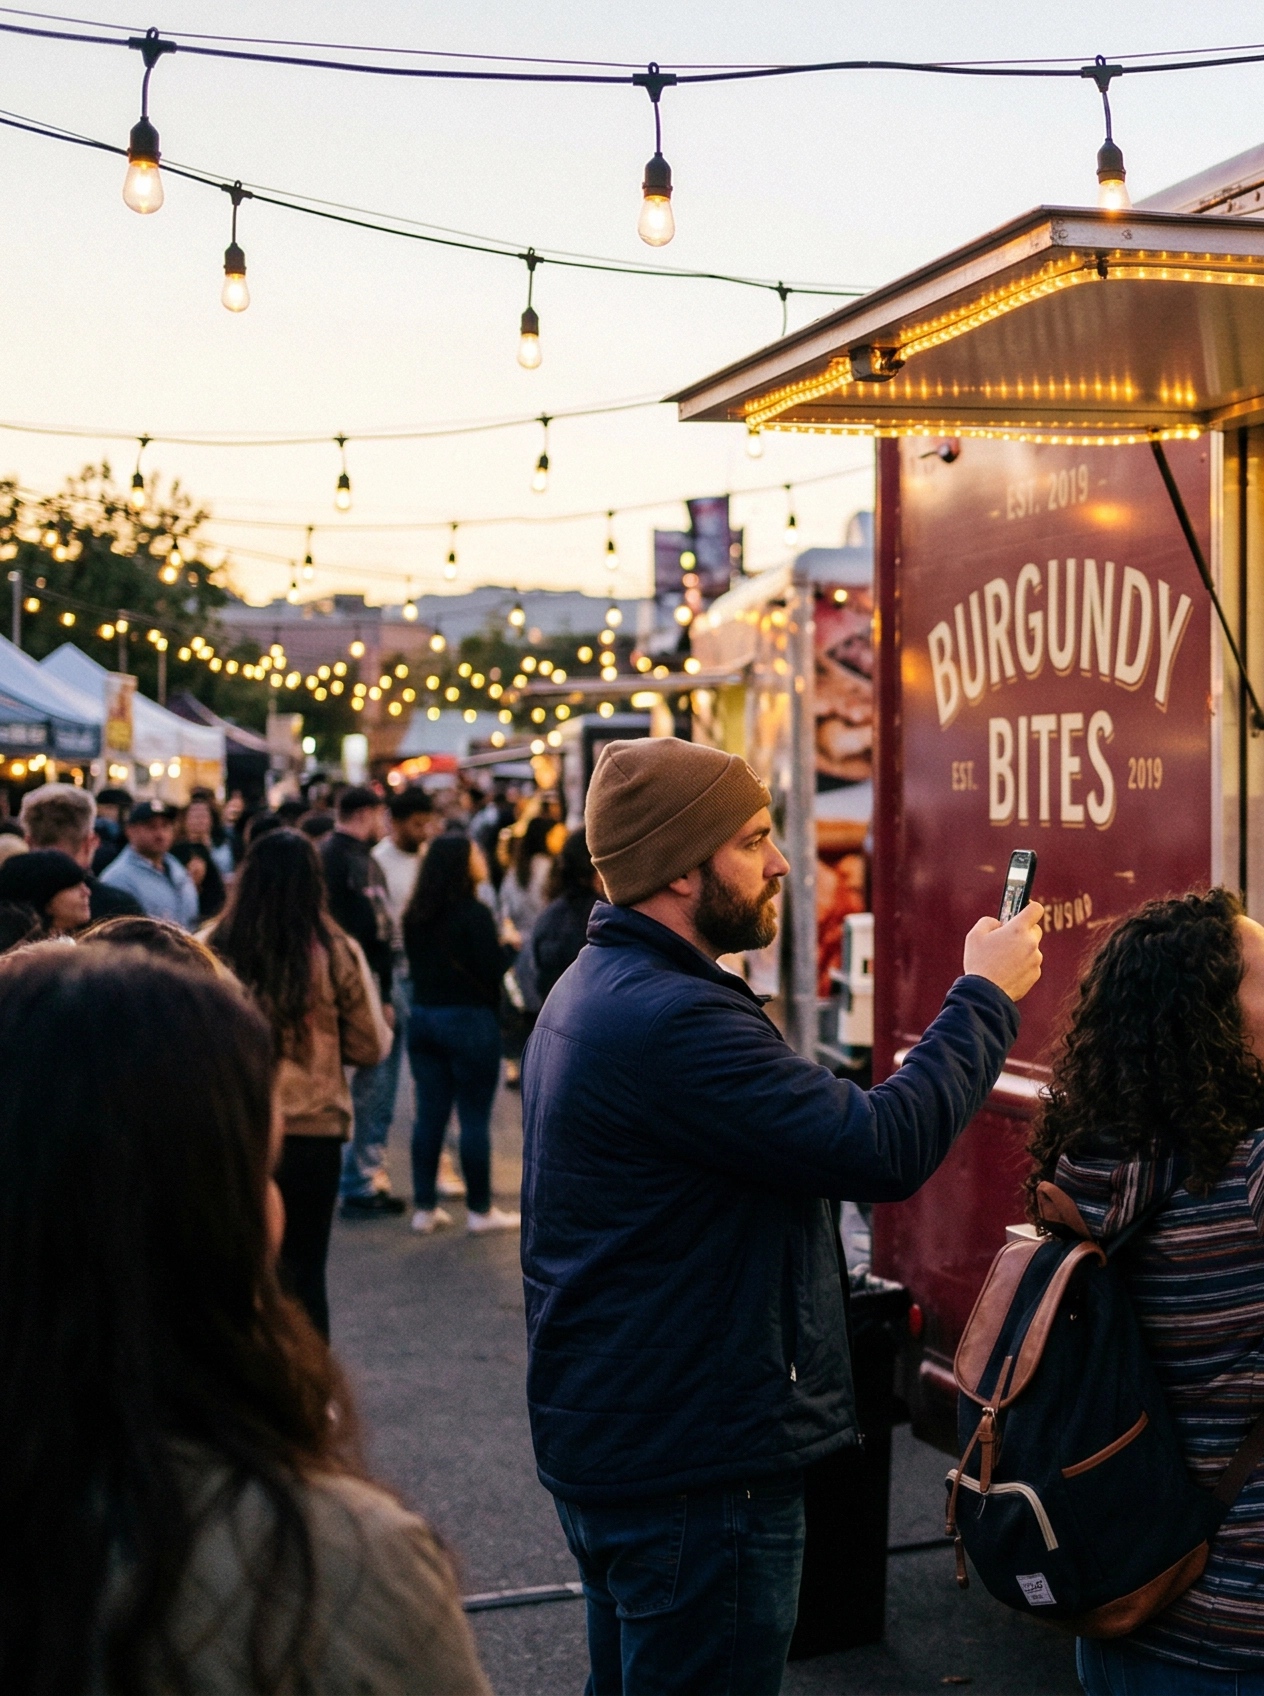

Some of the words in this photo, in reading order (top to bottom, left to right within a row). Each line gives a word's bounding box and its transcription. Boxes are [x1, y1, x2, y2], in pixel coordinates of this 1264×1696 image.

[1006, 481, 1042, 521] EST.
[1048, 464, 1089, 511] 2019
[928, 558, 1194, 732] BURGUNDY
[952, 760, 979, 791] EST.
[1128, 757, 1163, 789] 2019
[989, 709, 1117, 832] BITES
